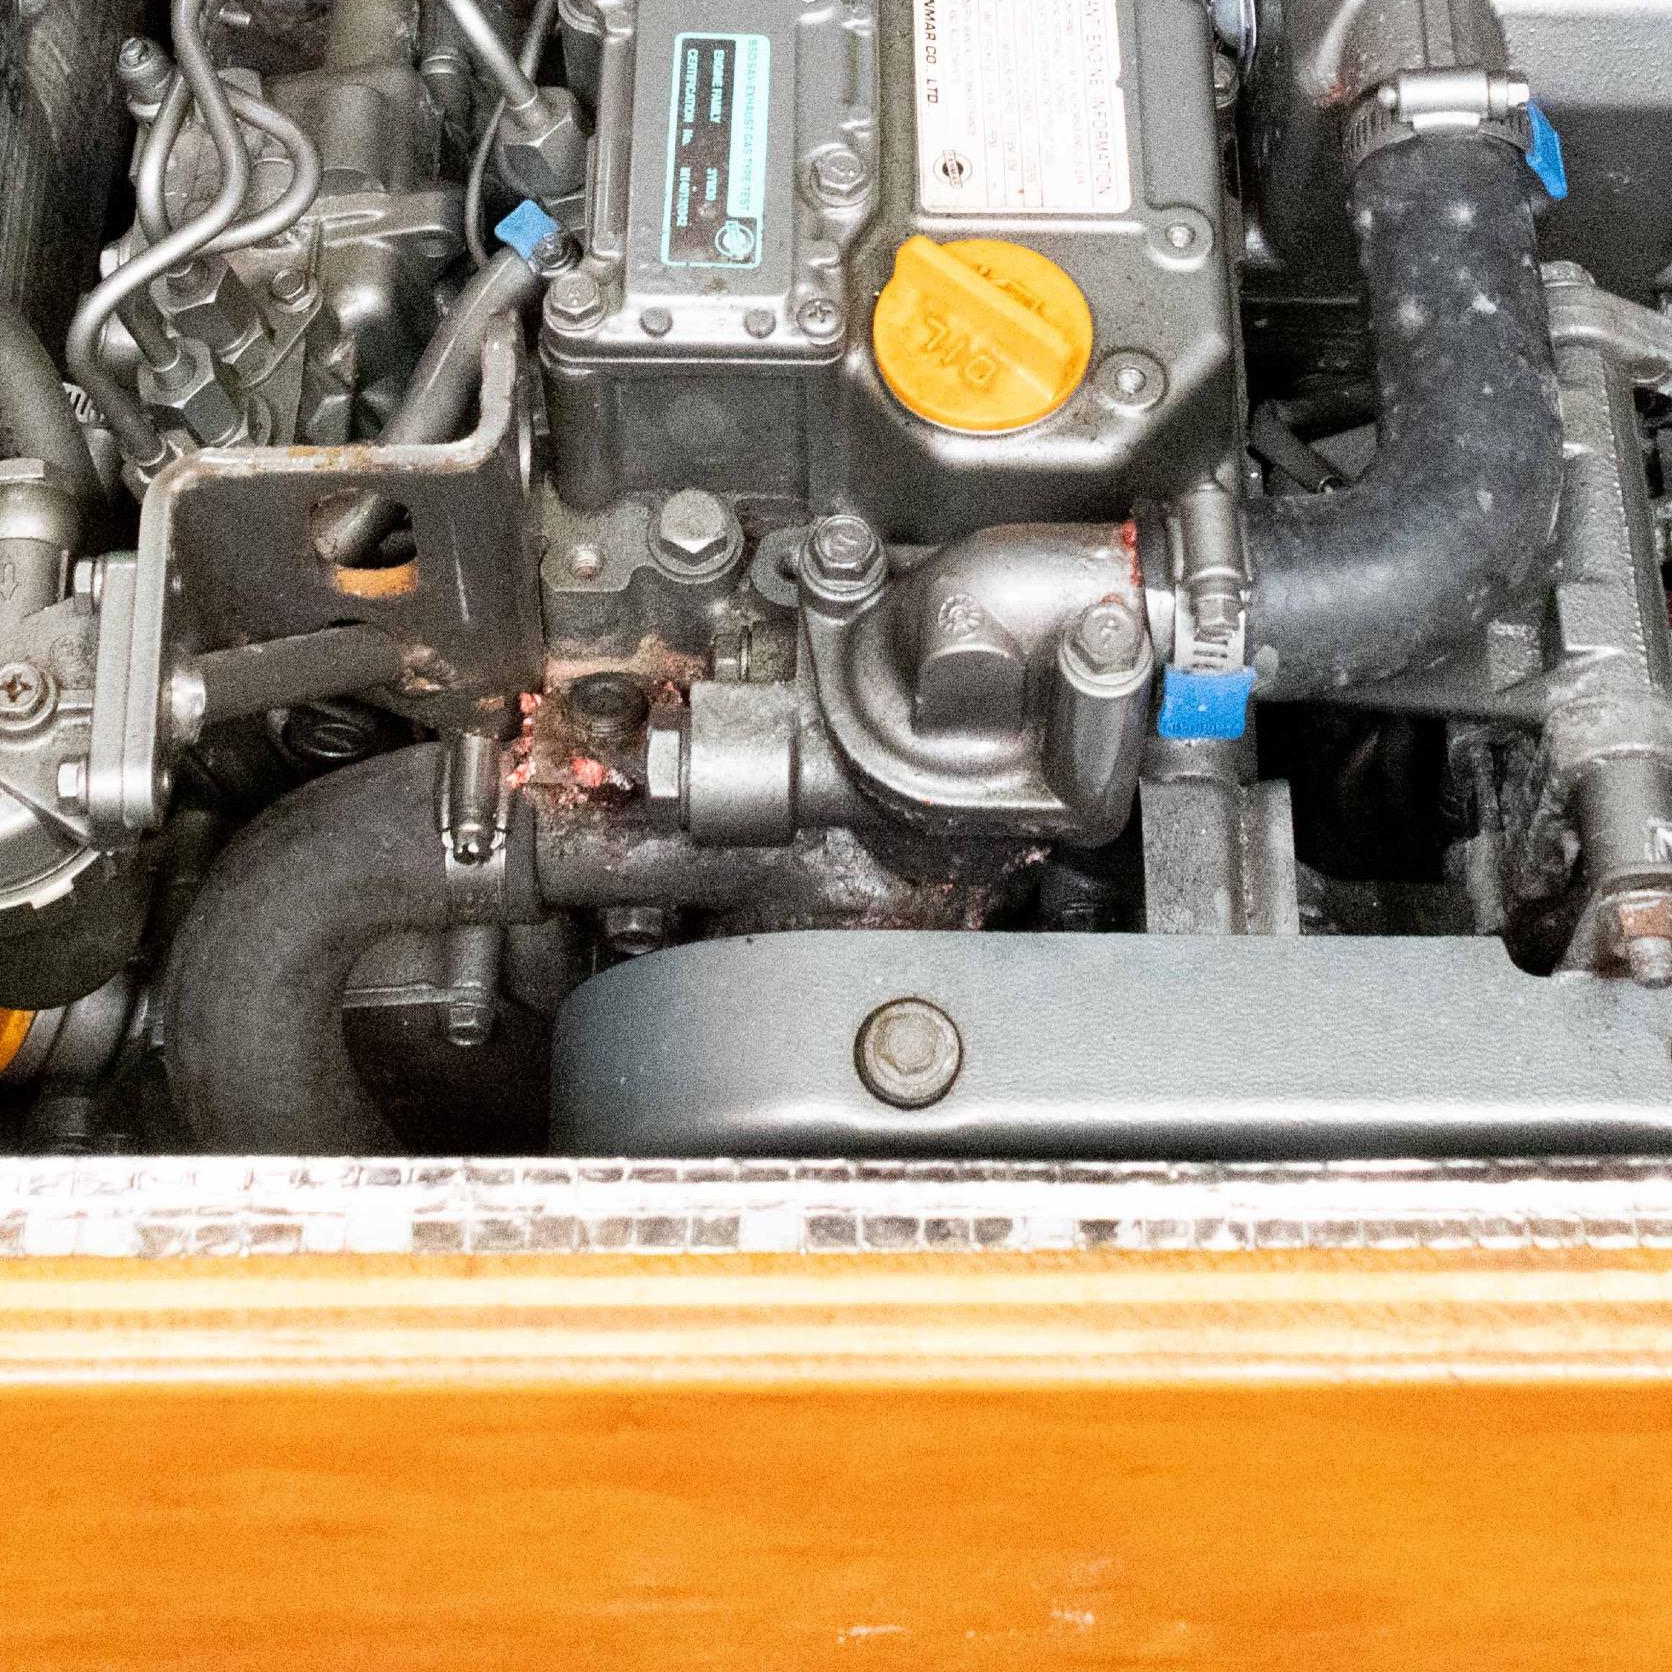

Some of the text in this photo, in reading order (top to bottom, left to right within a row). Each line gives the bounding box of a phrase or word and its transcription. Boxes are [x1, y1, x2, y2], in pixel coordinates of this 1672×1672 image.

[711, 49, 725, 87] ENGINE
[1086, 35, 1103, 86] ENGINE
[682, 48, 699, 123] CERTIFICATION
[709, 88, 722, 124] FAMILY
[743, 85, 755, 131] EXHAUST
[742, 133, 753, 154] GAS
[1091, 96, 1111, 196] INFORMATION
[739, 187, 751, 211] TEST
[923, 316, 997, 385] OIL
